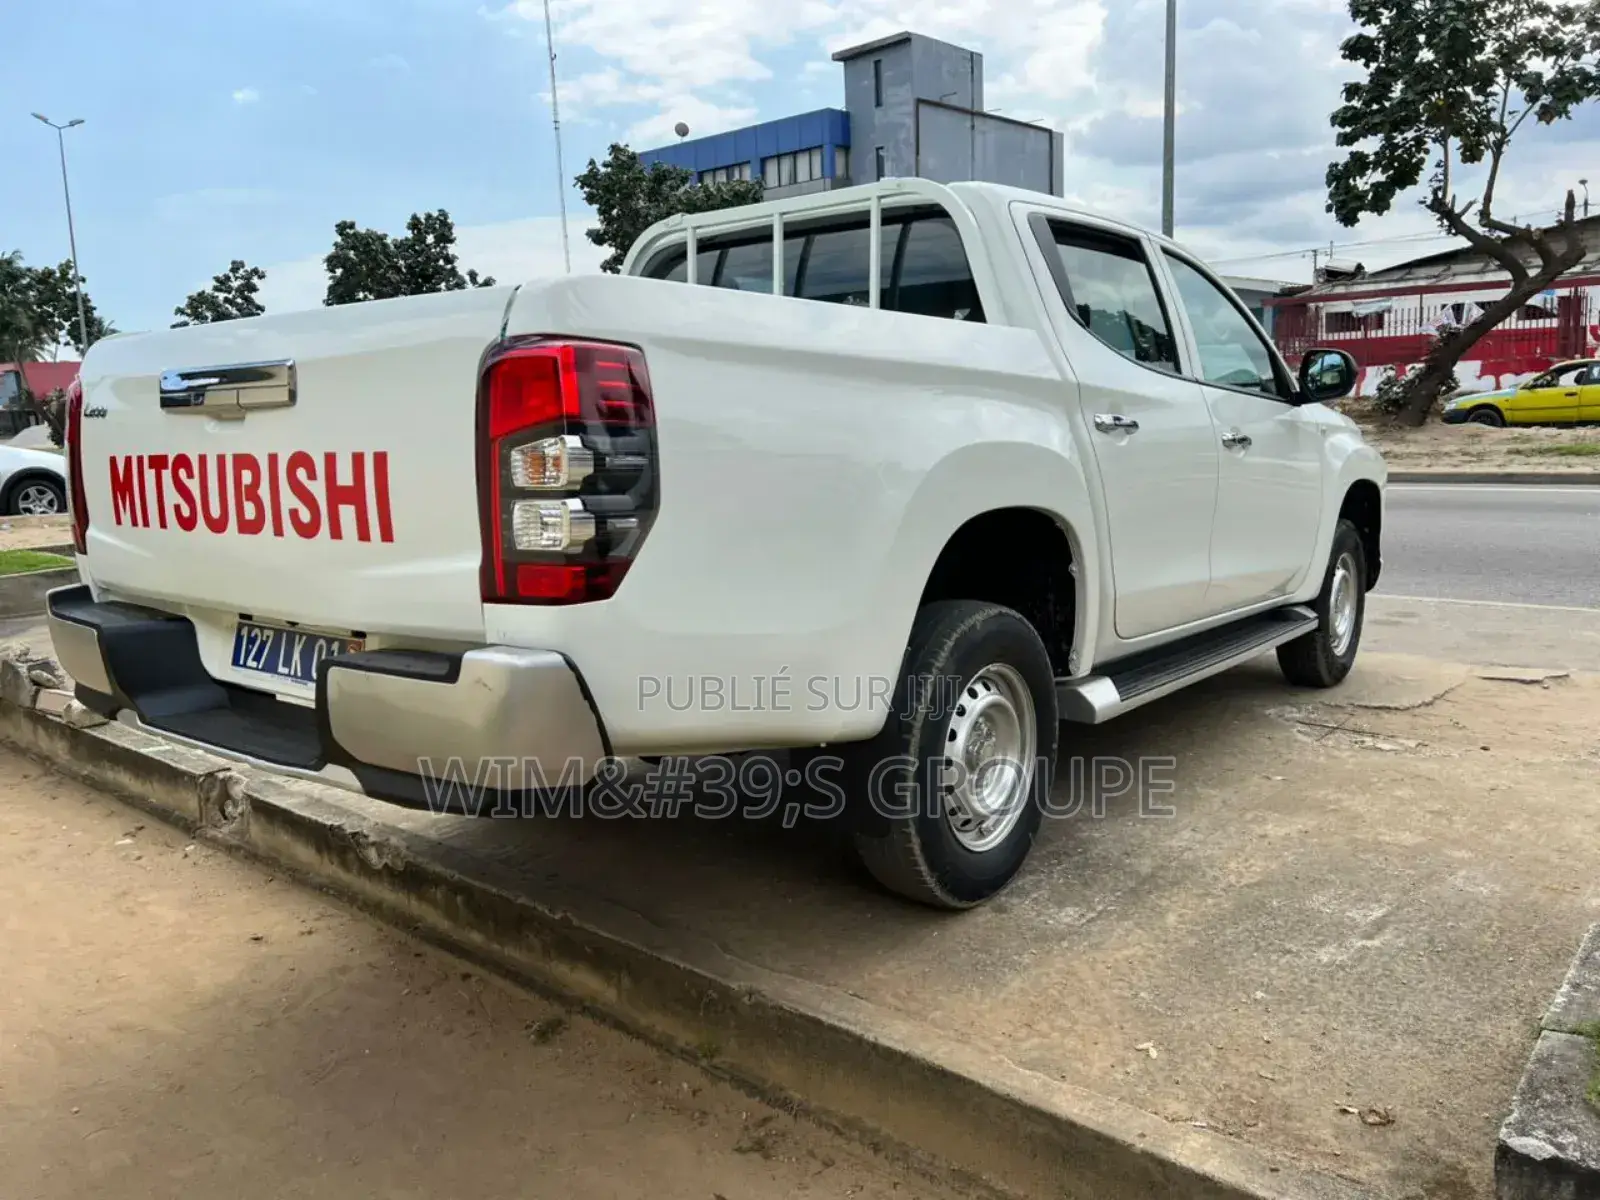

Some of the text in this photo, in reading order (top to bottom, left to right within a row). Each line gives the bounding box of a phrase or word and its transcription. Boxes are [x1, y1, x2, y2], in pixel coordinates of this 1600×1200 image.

[109, 450, 394, 543] MITSUBISHI
[239, 625, 275, 670] 127
[277, 631, 307, 677] LK
